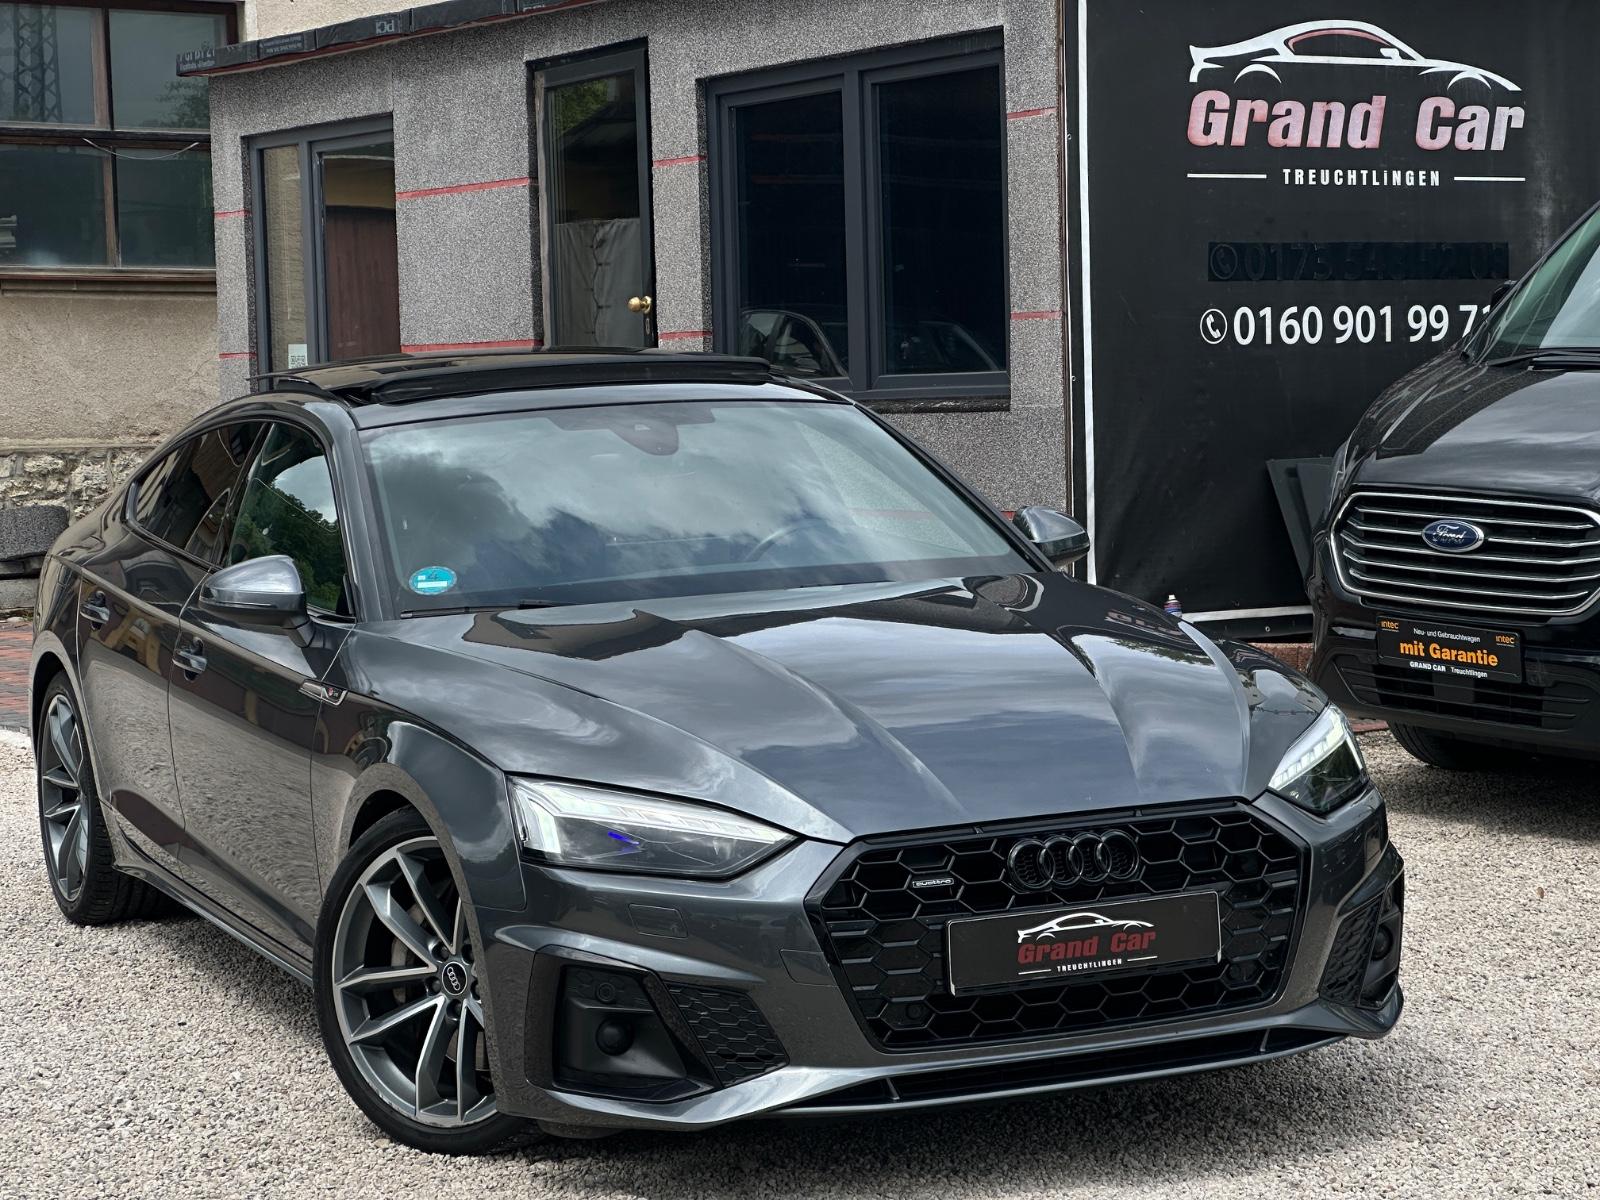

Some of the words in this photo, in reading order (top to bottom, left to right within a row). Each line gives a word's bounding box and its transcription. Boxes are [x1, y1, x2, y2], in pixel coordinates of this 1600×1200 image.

[1187, 90, 1387, 149] Grand
[1415, 96, 1525, 151] Car
[1233, 306, 1323, 346] 0160
[1333, 305, 1393, 344] 901
[1407, 304, 1449, 343] 99
[1459, 304, 1490, 338] 7
[1432, 524, 1467, 540] Ford
[1381, 620, 1400, 630] intec
[1496, 635, 1515, 644] intec
[1400, 640, 1425, 657] mit
[1429, 642, 1499, 667] Garantie
[1409, 661, 1431, 670] GRAND
[1432, 664, 1446, 673] CAR
[1450, 666, 1488, 679] Treuchtlingen
[1018, 935, 1099, 964] Grand
[1110, 931, 1156, 953] Car
[1057, 958, 1122, 972] TREUCHTLINGEN
